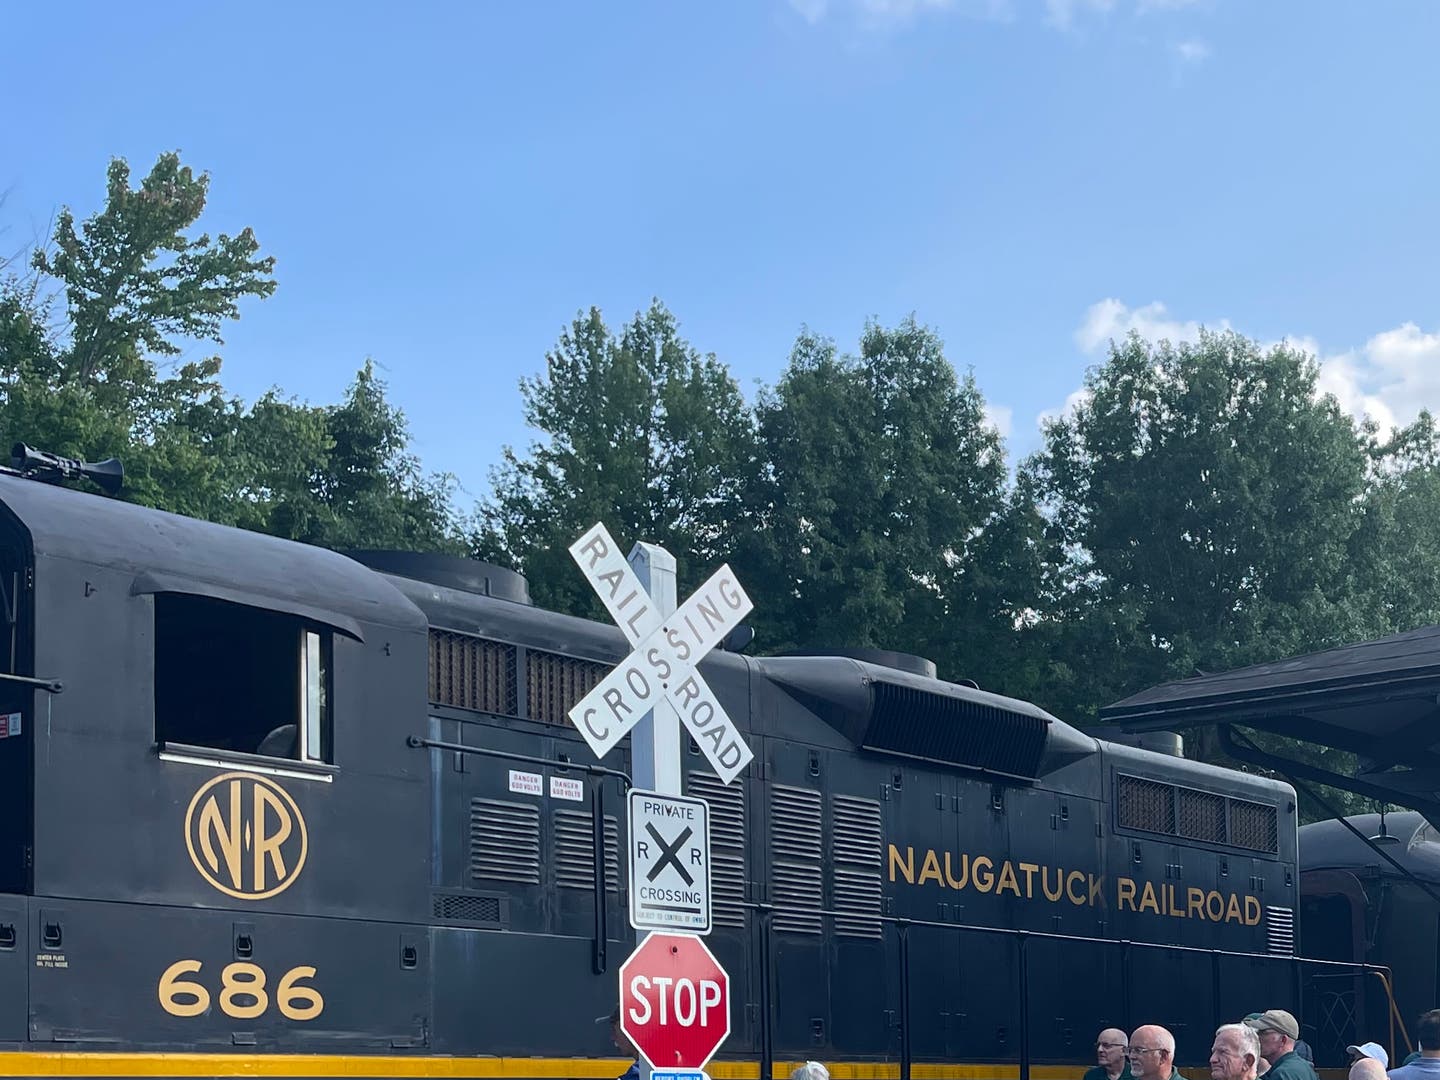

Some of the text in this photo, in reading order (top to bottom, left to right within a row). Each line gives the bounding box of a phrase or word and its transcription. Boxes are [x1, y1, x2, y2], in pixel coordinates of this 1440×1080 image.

[580, 534, 741, 769] RAIL ROAD
[583, 578, 742, 741] CROSSING
[644, 801, 694, 820] PRIVATE
[637, 841, 649, 860] R
[691, 848, 702, 866] R
[640, 886, 701, 904] CROSSING
[888, 843, 1261, 926] NAUGATUCK RAILROAD
[158, 959, 324, 1021] 686
[629, 975, 722, 1027] STOP
